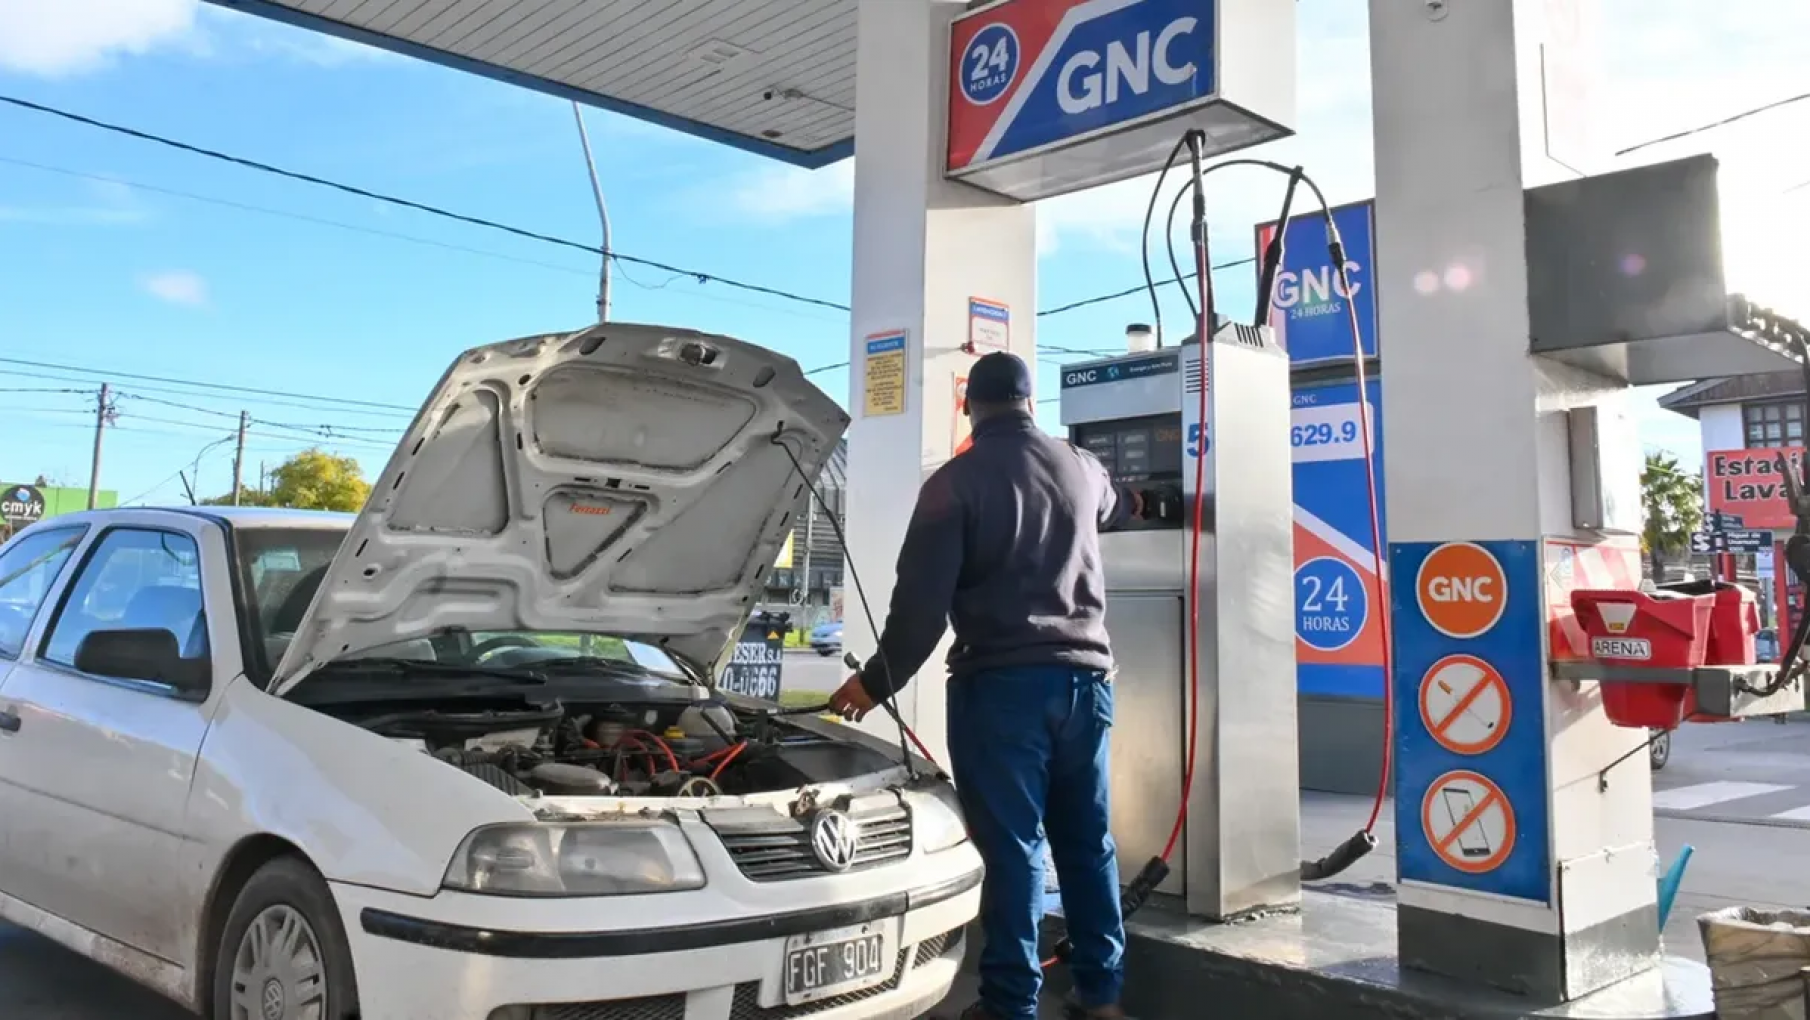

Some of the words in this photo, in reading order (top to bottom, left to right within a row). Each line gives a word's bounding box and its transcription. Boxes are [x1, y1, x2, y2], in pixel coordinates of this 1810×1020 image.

[972, 36, 1009, 81] 24
[1056, 17, 1198, 114] GNC
[970, 73, 1006, 92] HORAS
[1272, 261, 1361, 308] GNC
[1290, 308, 1303, 320] 24
[1305, 302, 1341, 317] HORAS
[1066, 370, 1097, 385] GNC
[1293, 394, 1317, 405] GNC
[1186, 423, 1211, 458] 5
[1290, 421, 1356, 447] 629.9
[1, 500, 42, 516] cmyk
[1302, 576, 1348, 612] 24
[1428, 576, 1493, 603] GNC
[1303, 616, 1350, 632] HORAS
[1594, 641, 1646, 655] ARENA
[789, 947, 828, 991] FGF
[843, 936, 879, 979] 904
